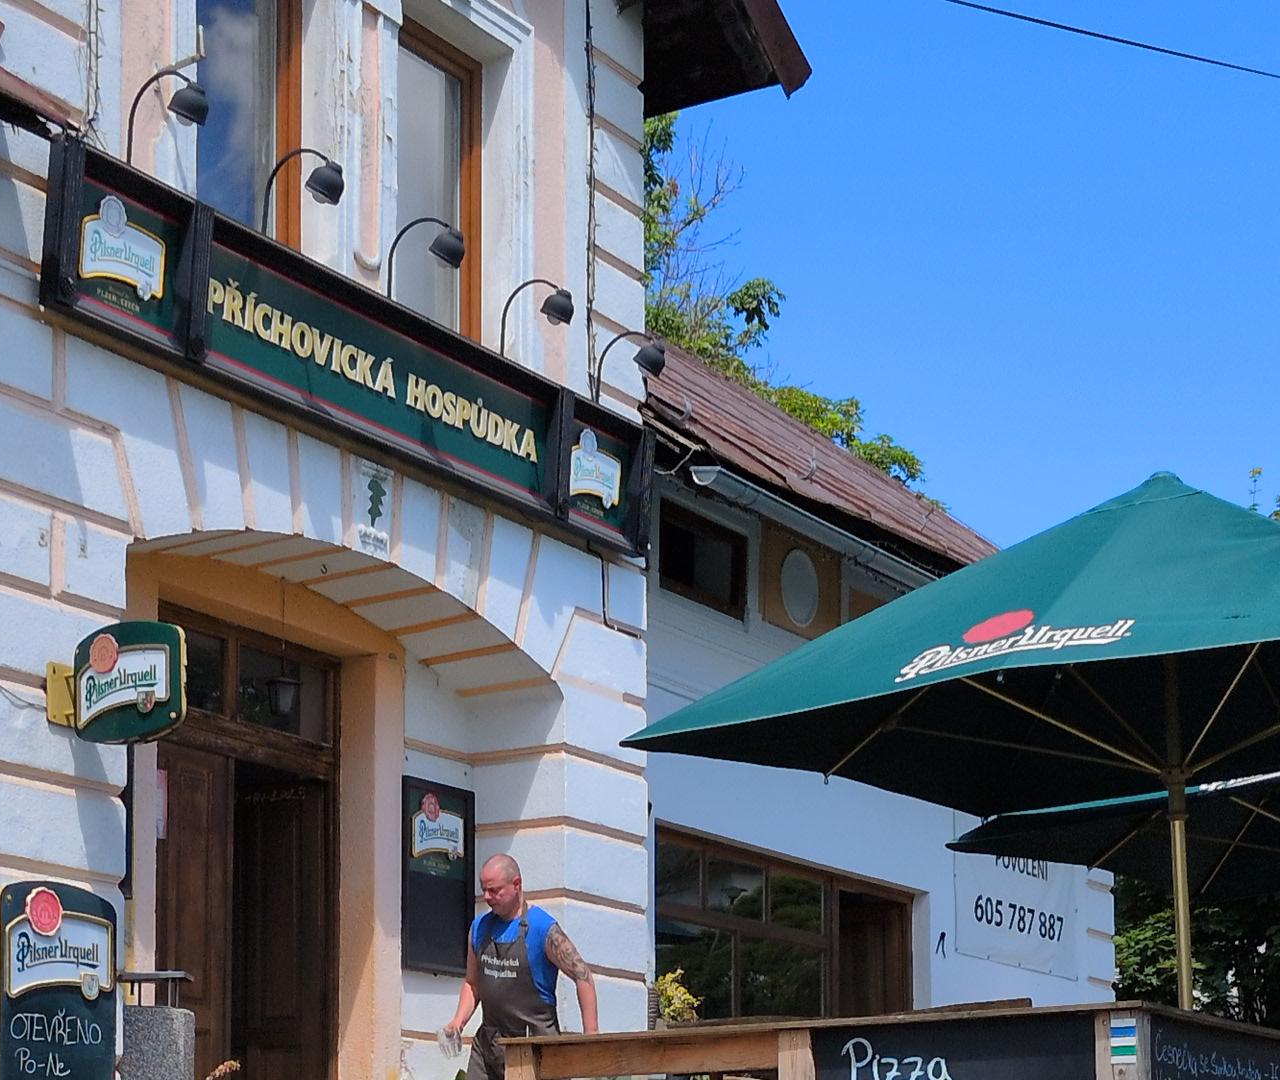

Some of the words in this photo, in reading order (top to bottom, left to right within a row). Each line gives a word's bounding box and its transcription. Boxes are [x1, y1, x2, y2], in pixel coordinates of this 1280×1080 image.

[90, 230, 123, 262] Pilsner
[123, 241, 156, 274] Urquell
[206, 277, 397, 399] PŘÍCHOVICKÁ
[405, 371, 539, 463] HOSPŮDKA
[894, 636, 1022, 683] Pilsner
[85, 675, 120, 710] Pilsner
[119, 664, 157, 692] Urquell
[974, 894, 1003, 927] 605
[1008, 902, 1036, 935] 787
[1038, 911, 1064, 943] 887
[16, 931, 59, 972] Pilsner
[58, 936, 100, 969] Urquell
[10, 1007, 102, 1046] OTEVŘENO
